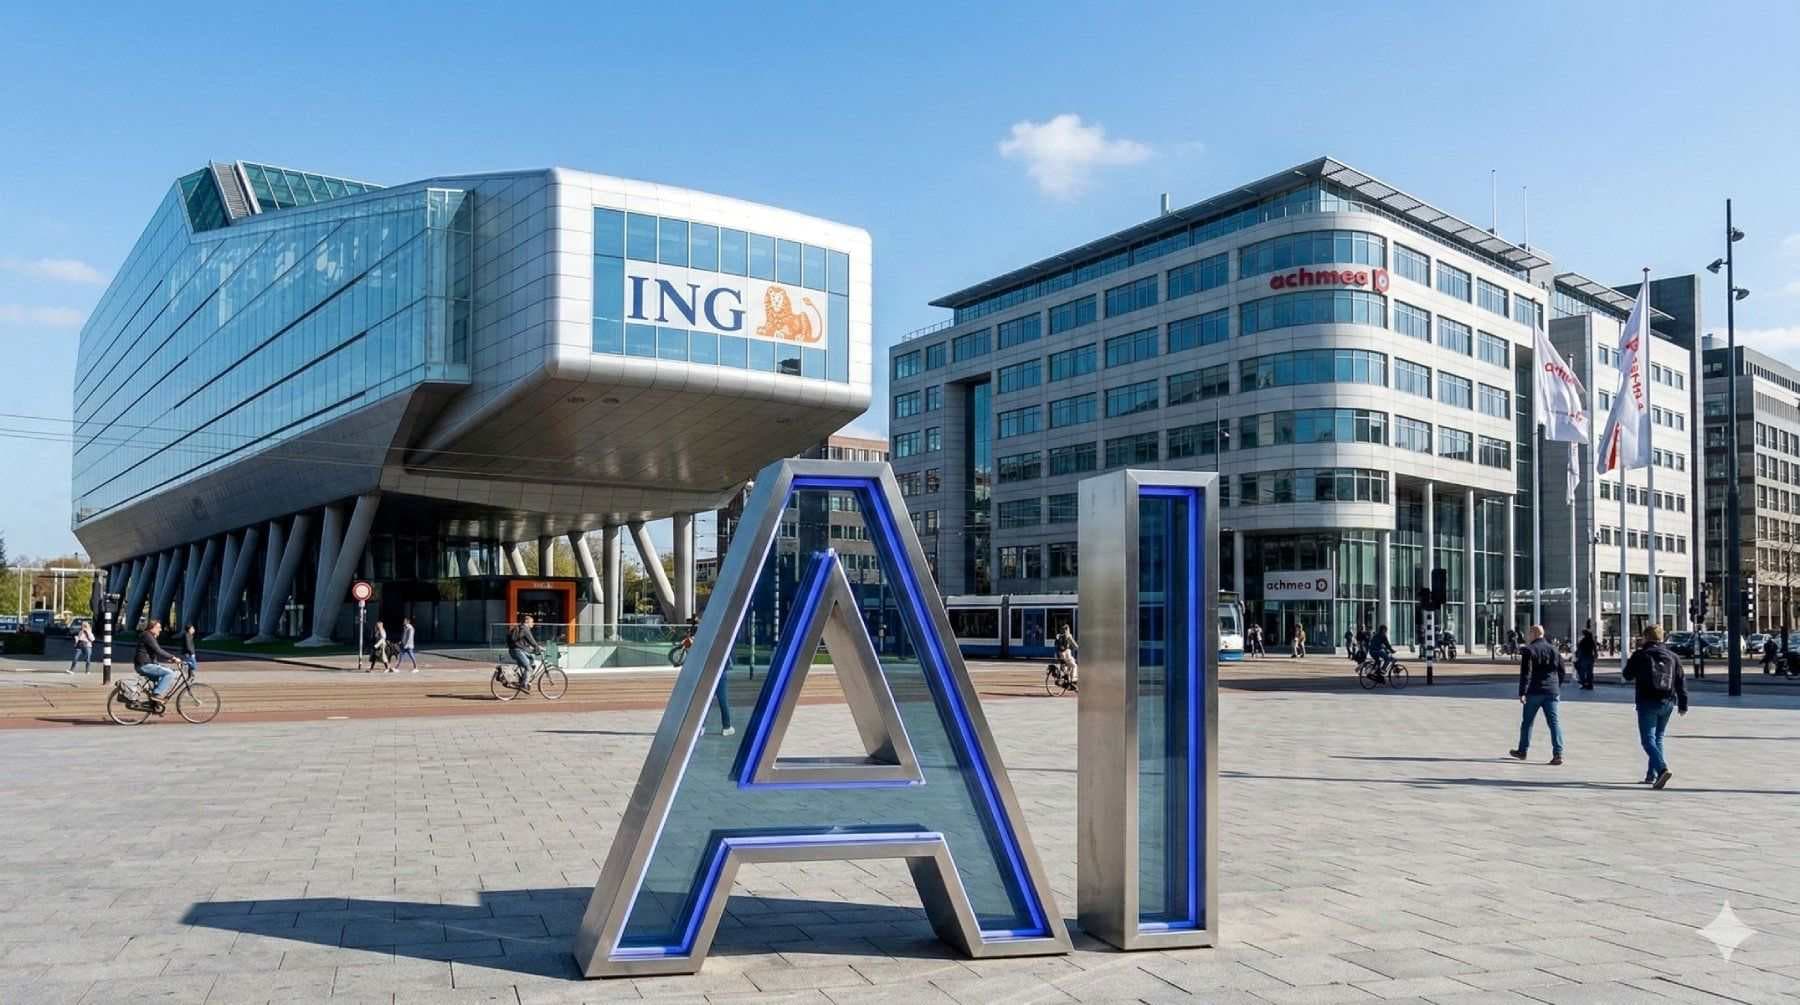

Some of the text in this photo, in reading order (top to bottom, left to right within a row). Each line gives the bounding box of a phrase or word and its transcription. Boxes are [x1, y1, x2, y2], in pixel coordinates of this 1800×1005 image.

[1269, 267, 1369, 290] achmea
[627, 275, 746, 332] ING
[1266, 579, 1312, 591] achmea
[572, 458, 1219, 979] AI
